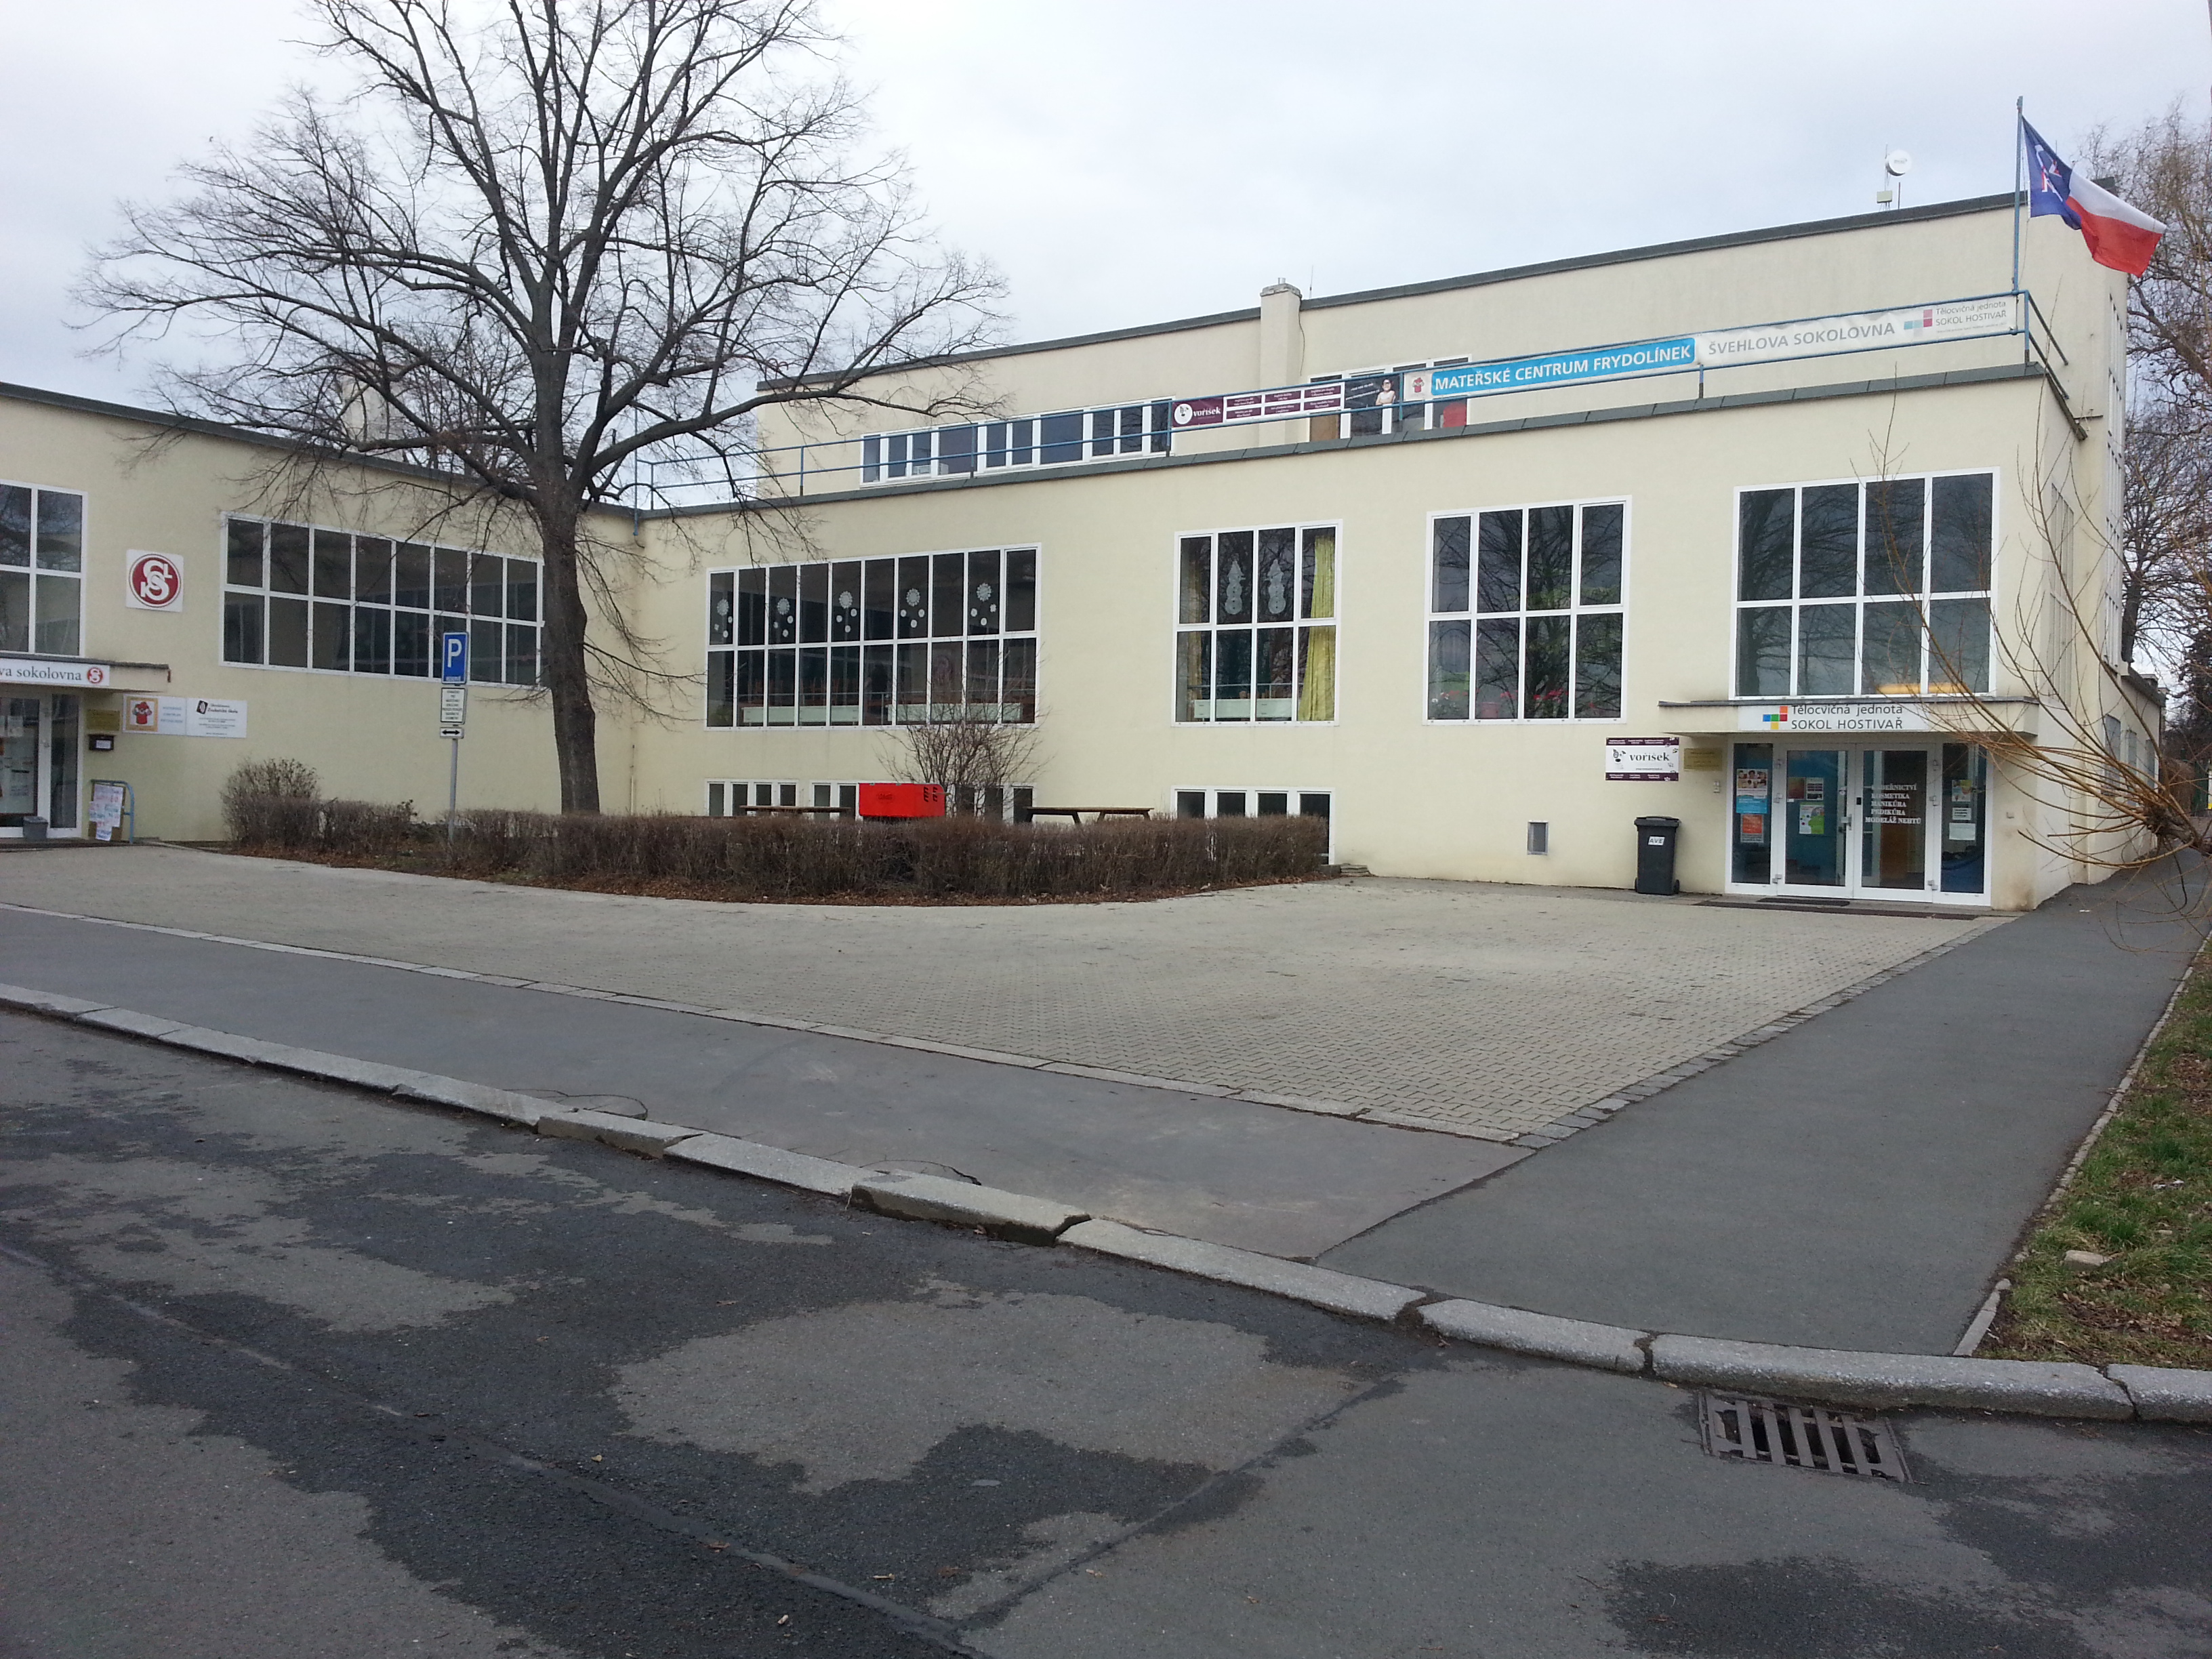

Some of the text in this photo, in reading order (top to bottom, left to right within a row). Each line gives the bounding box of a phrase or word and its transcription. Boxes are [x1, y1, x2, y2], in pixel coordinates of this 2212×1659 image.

[1936, 302, 2006, 314] Tělocvičná jednota
[1936, 310, 2007, 326] SOKOL HOSTIVAŘ
[1708, 322, 1896, 355] ŠVEHLOVA SOKOLOVNA
[1435, 344, 1691, 391] MATEŘSKÉ CENTRUM FRYDOLÍNEK
[447, 638, 462, 668] P
[16, 665, 81, 680] sokolovna
[1791, 704, 1903, 717] Tělocvičná jednota
[1791, 716, 1903, 730] SOKOL HOSTIVAŘ
[1871, 783, 1917, 792] DEŘNICTVÍ
